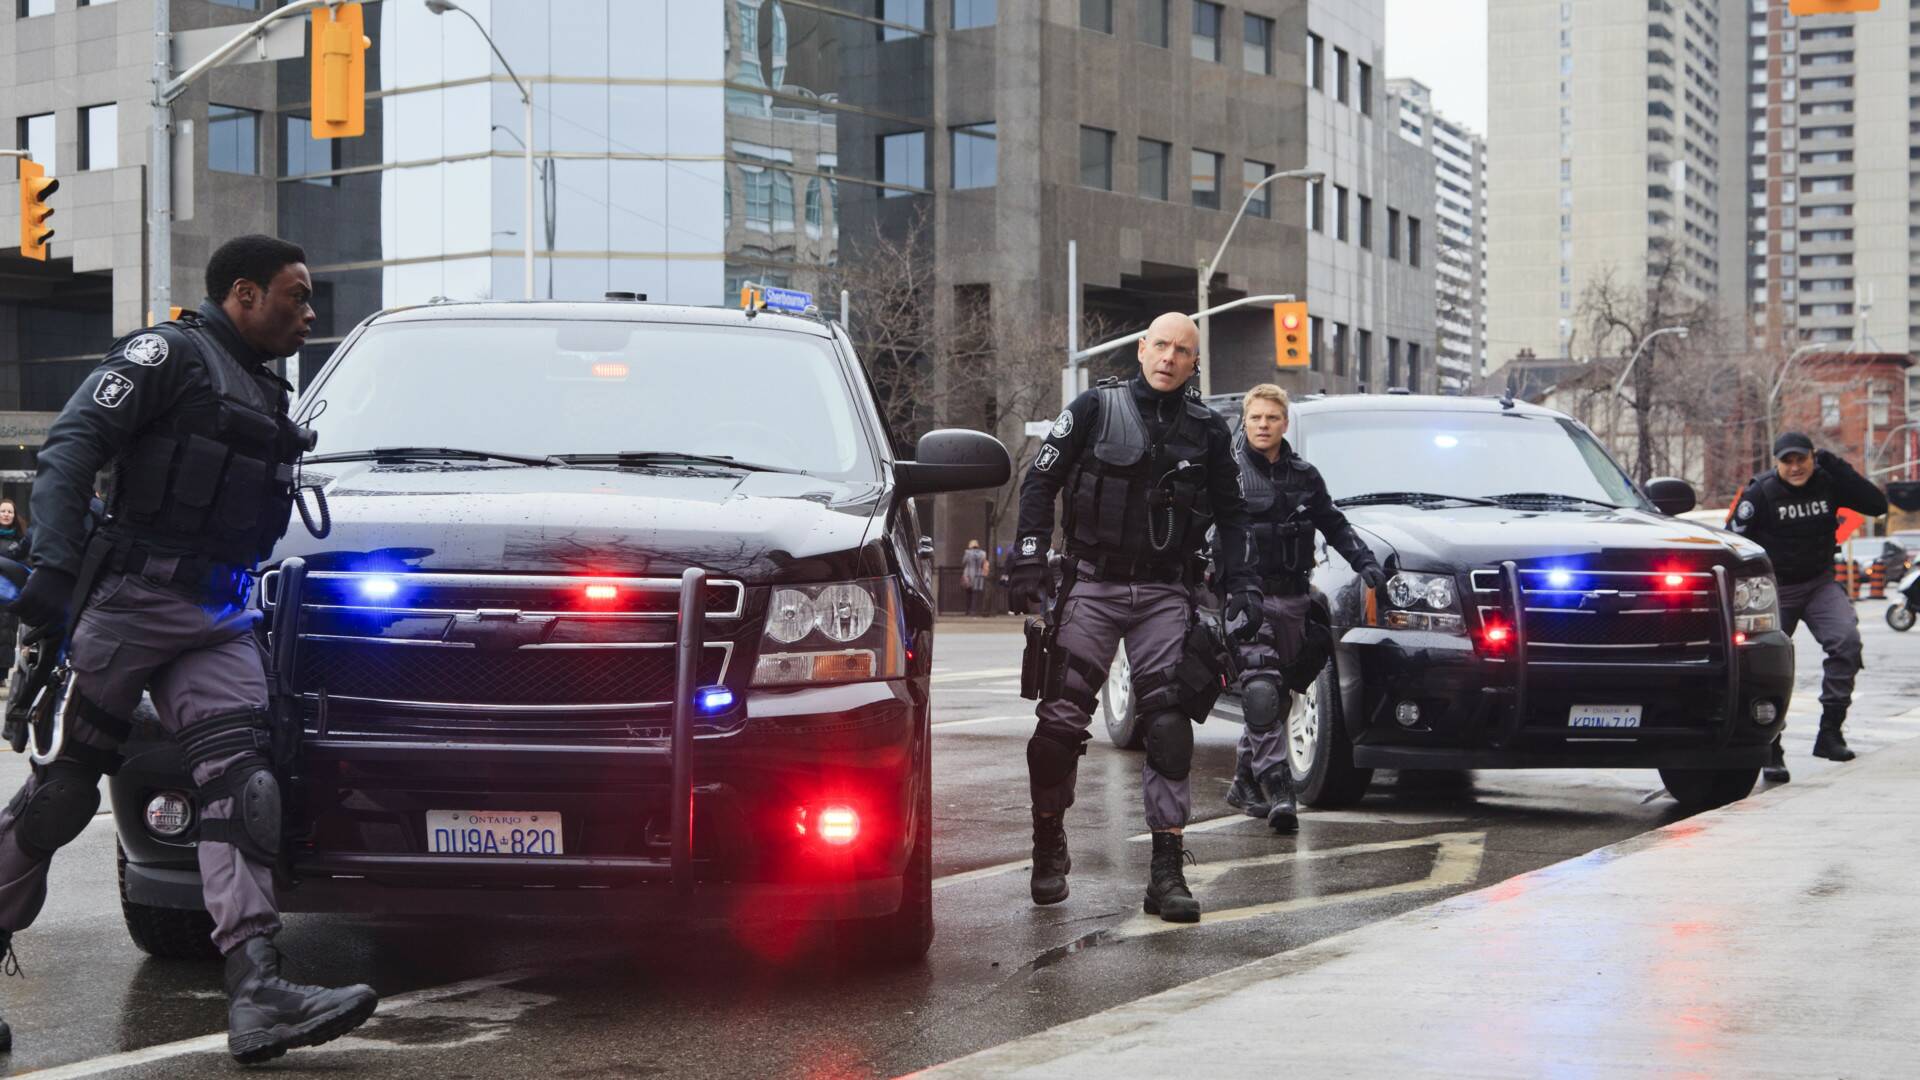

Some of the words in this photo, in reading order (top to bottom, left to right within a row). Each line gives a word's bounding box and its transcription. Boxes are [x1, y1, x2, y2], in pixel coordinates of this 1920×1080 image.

[1778, 500, 1829, 520] POLICE
[469, 815, 521, 825] ONTARIO
[435, 828, 499, 854] DU9A
[511, 829, 556, 855] 820
